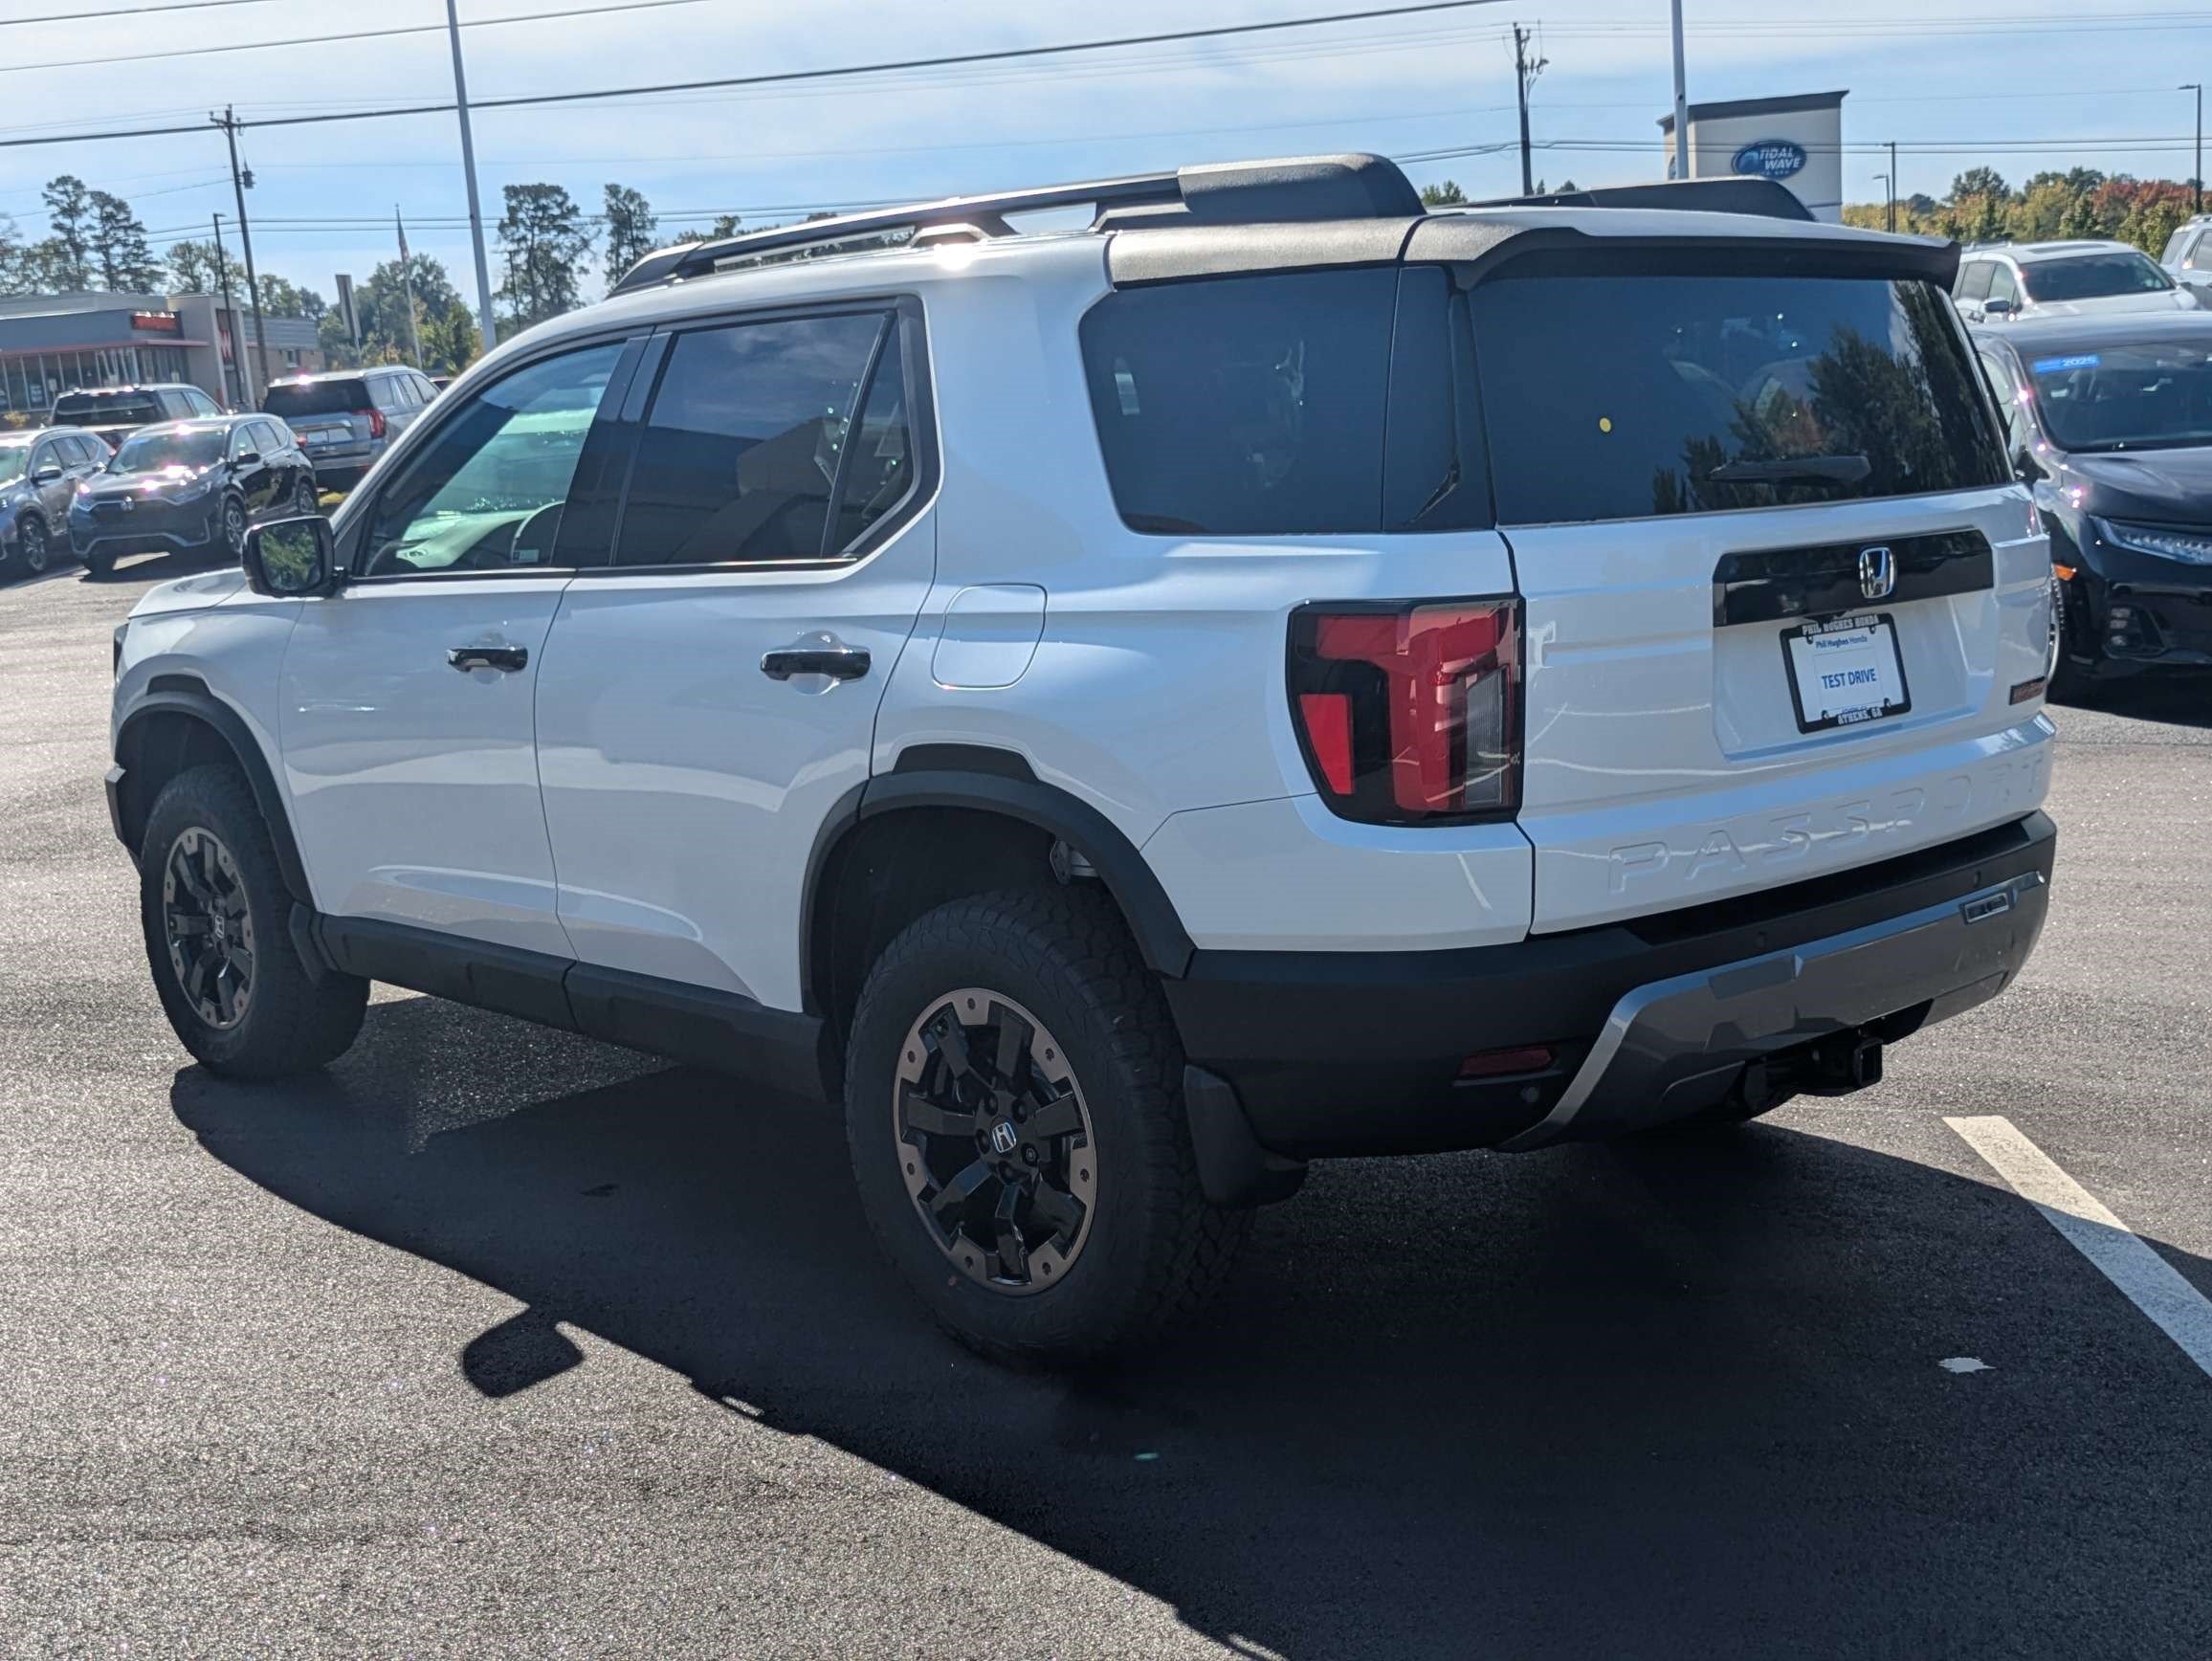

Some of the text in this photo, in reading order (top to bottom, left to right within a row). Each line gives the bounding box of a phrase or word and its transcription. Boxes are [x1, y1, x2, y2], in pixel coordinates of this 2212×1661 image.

[1760, 146, 1793, 160] TIDAL
[1765, 158, 1800, 169] WAVE
[1815, 633, 1868, 649] Phil Hughes Honda
[1822, 668, 1876, 689] TEST DRIVE
